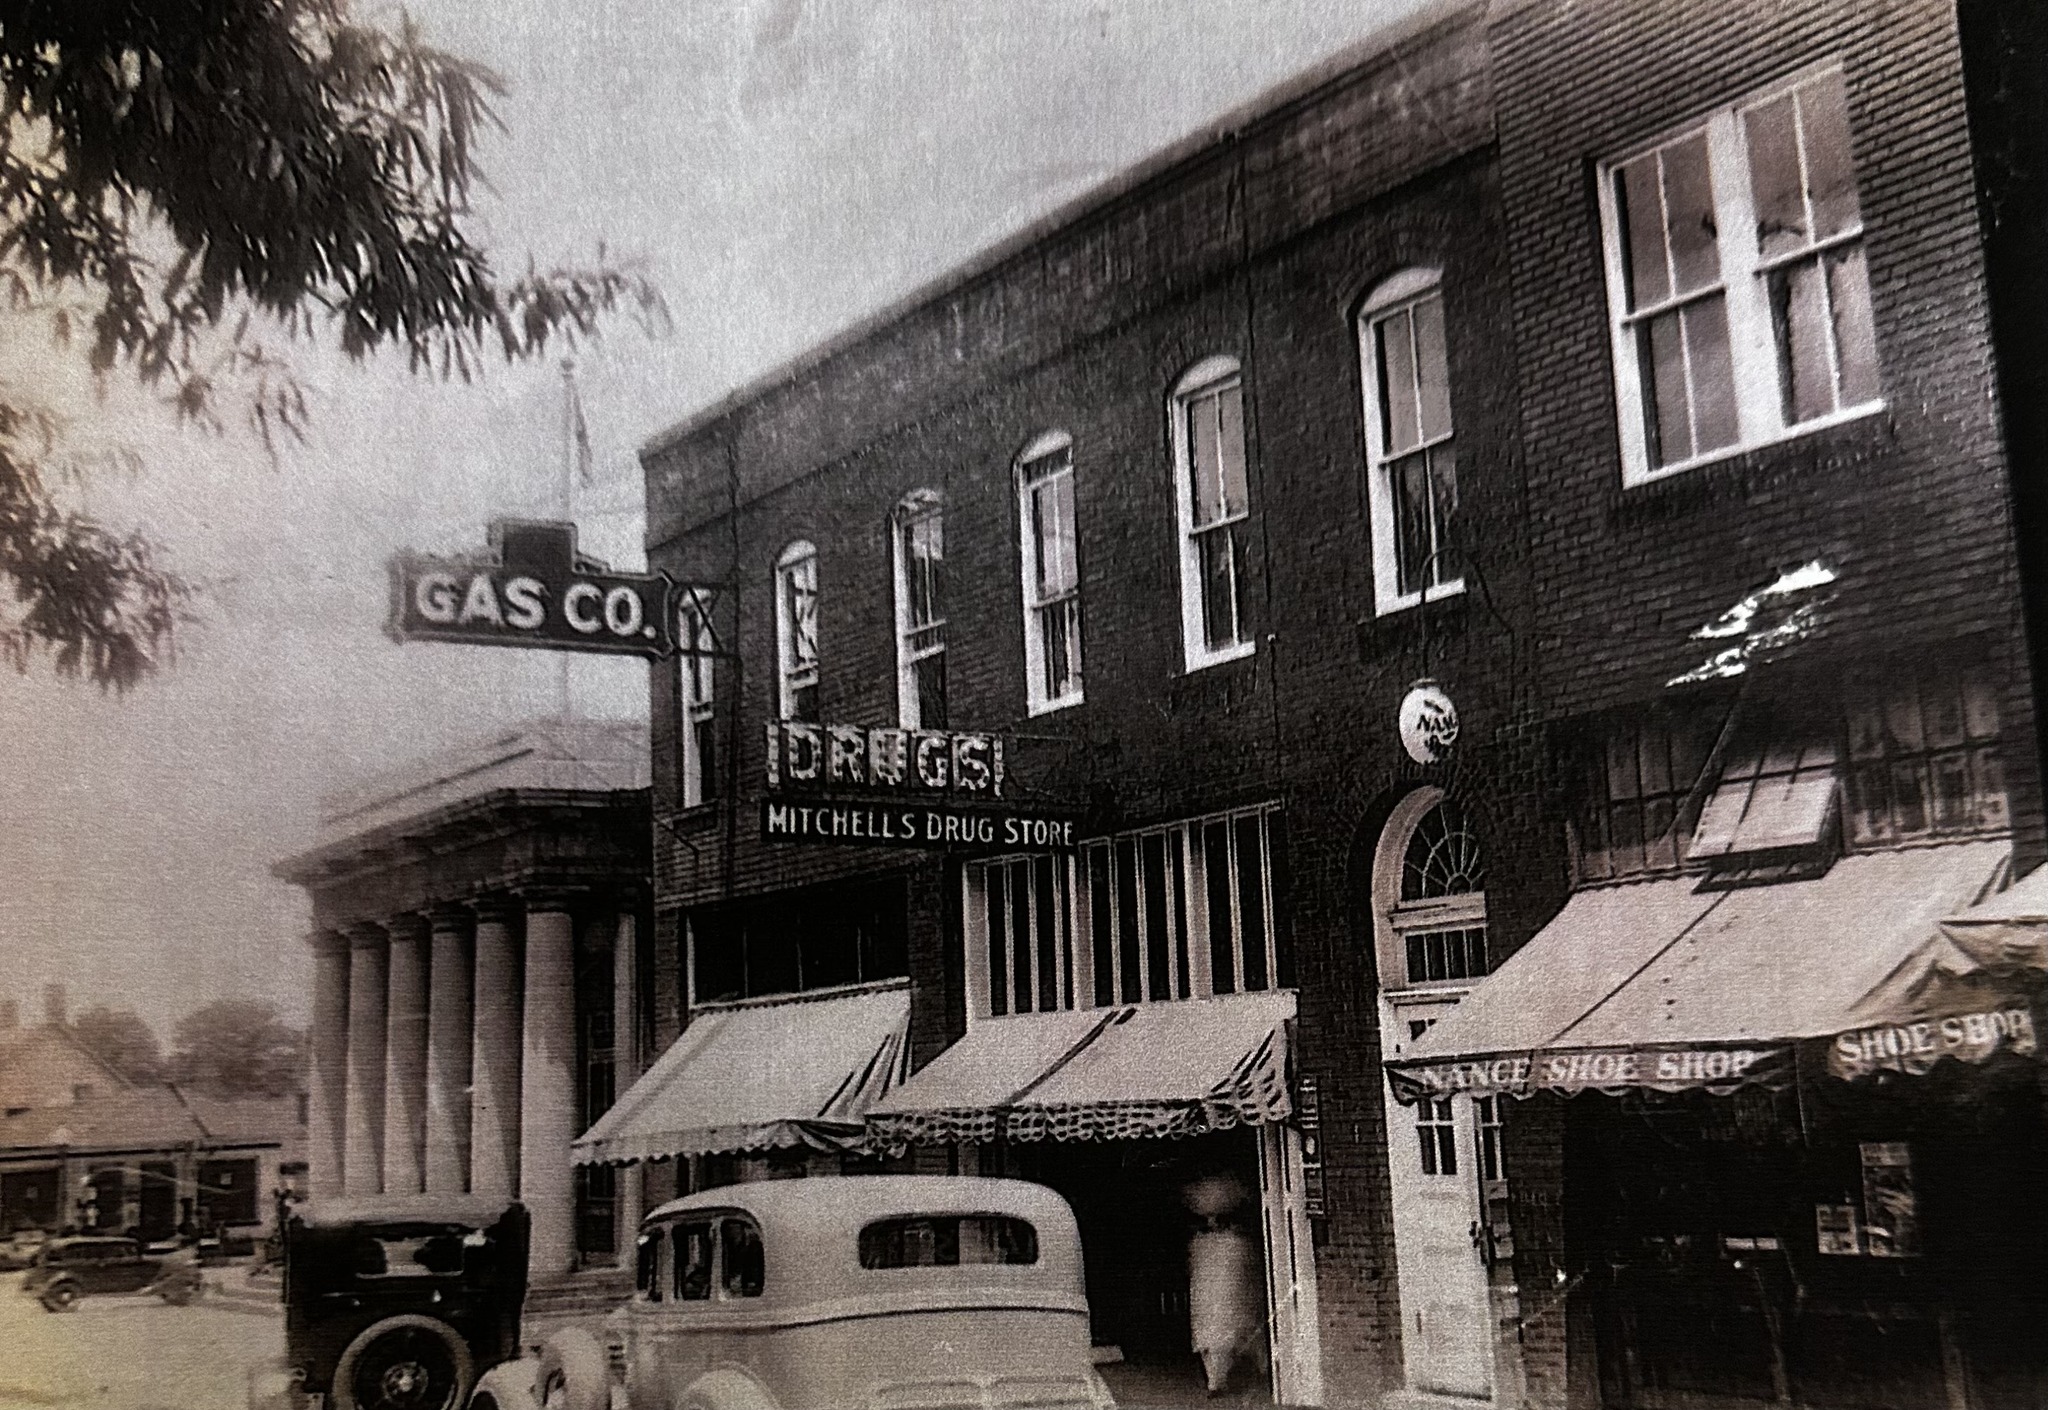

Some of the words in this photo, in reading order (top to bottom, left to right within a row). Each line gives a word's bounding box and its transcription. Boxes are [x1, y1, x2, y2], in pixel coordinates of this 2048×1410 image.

[416, 571, 549, 630] GAS
[563, 582, 657, 636] CO.
[927, 812, 994, 843] DRUG
[1004, 817, 1074, 847] STORE
[1836, 1022, 1934, 1062] SHOE
[1550, 1053, 1638, 1083] SHOE
[1656, 1050, 1754, 1080] SHOP
